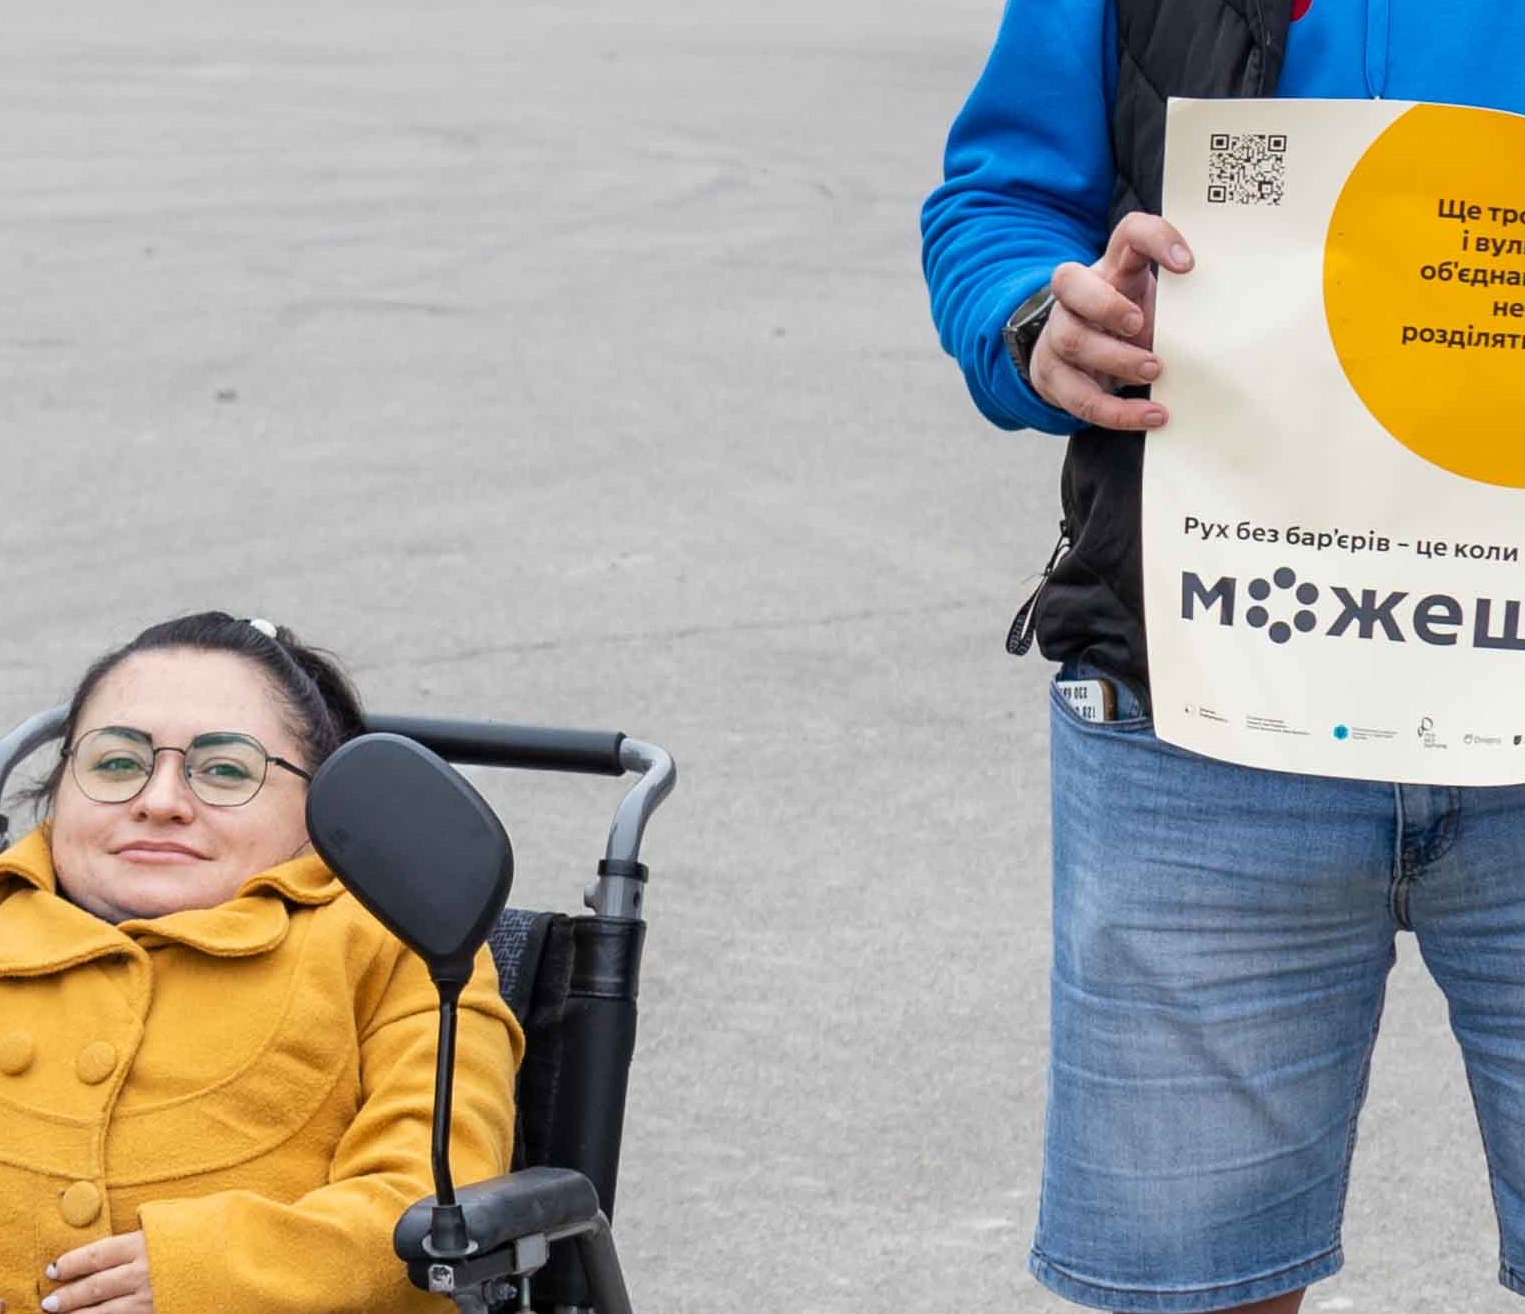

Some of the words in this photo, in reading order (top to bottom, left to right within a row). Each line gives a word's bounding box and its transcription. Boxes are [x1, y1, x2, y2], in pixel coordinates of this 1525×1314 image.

[1437, 198, 1482, 224] Ще
[1461, 229, 1470, 252] і
[1491, 300, 1525, 318] не
[1183, 516, 1230, 540] Рух
[1236, 521, 1280, 543] без
[1285, 526, 1391, 554] бар’єрів
[1416, 540, 1448, 559] це
[1453, 541, 1519, 562] коли
